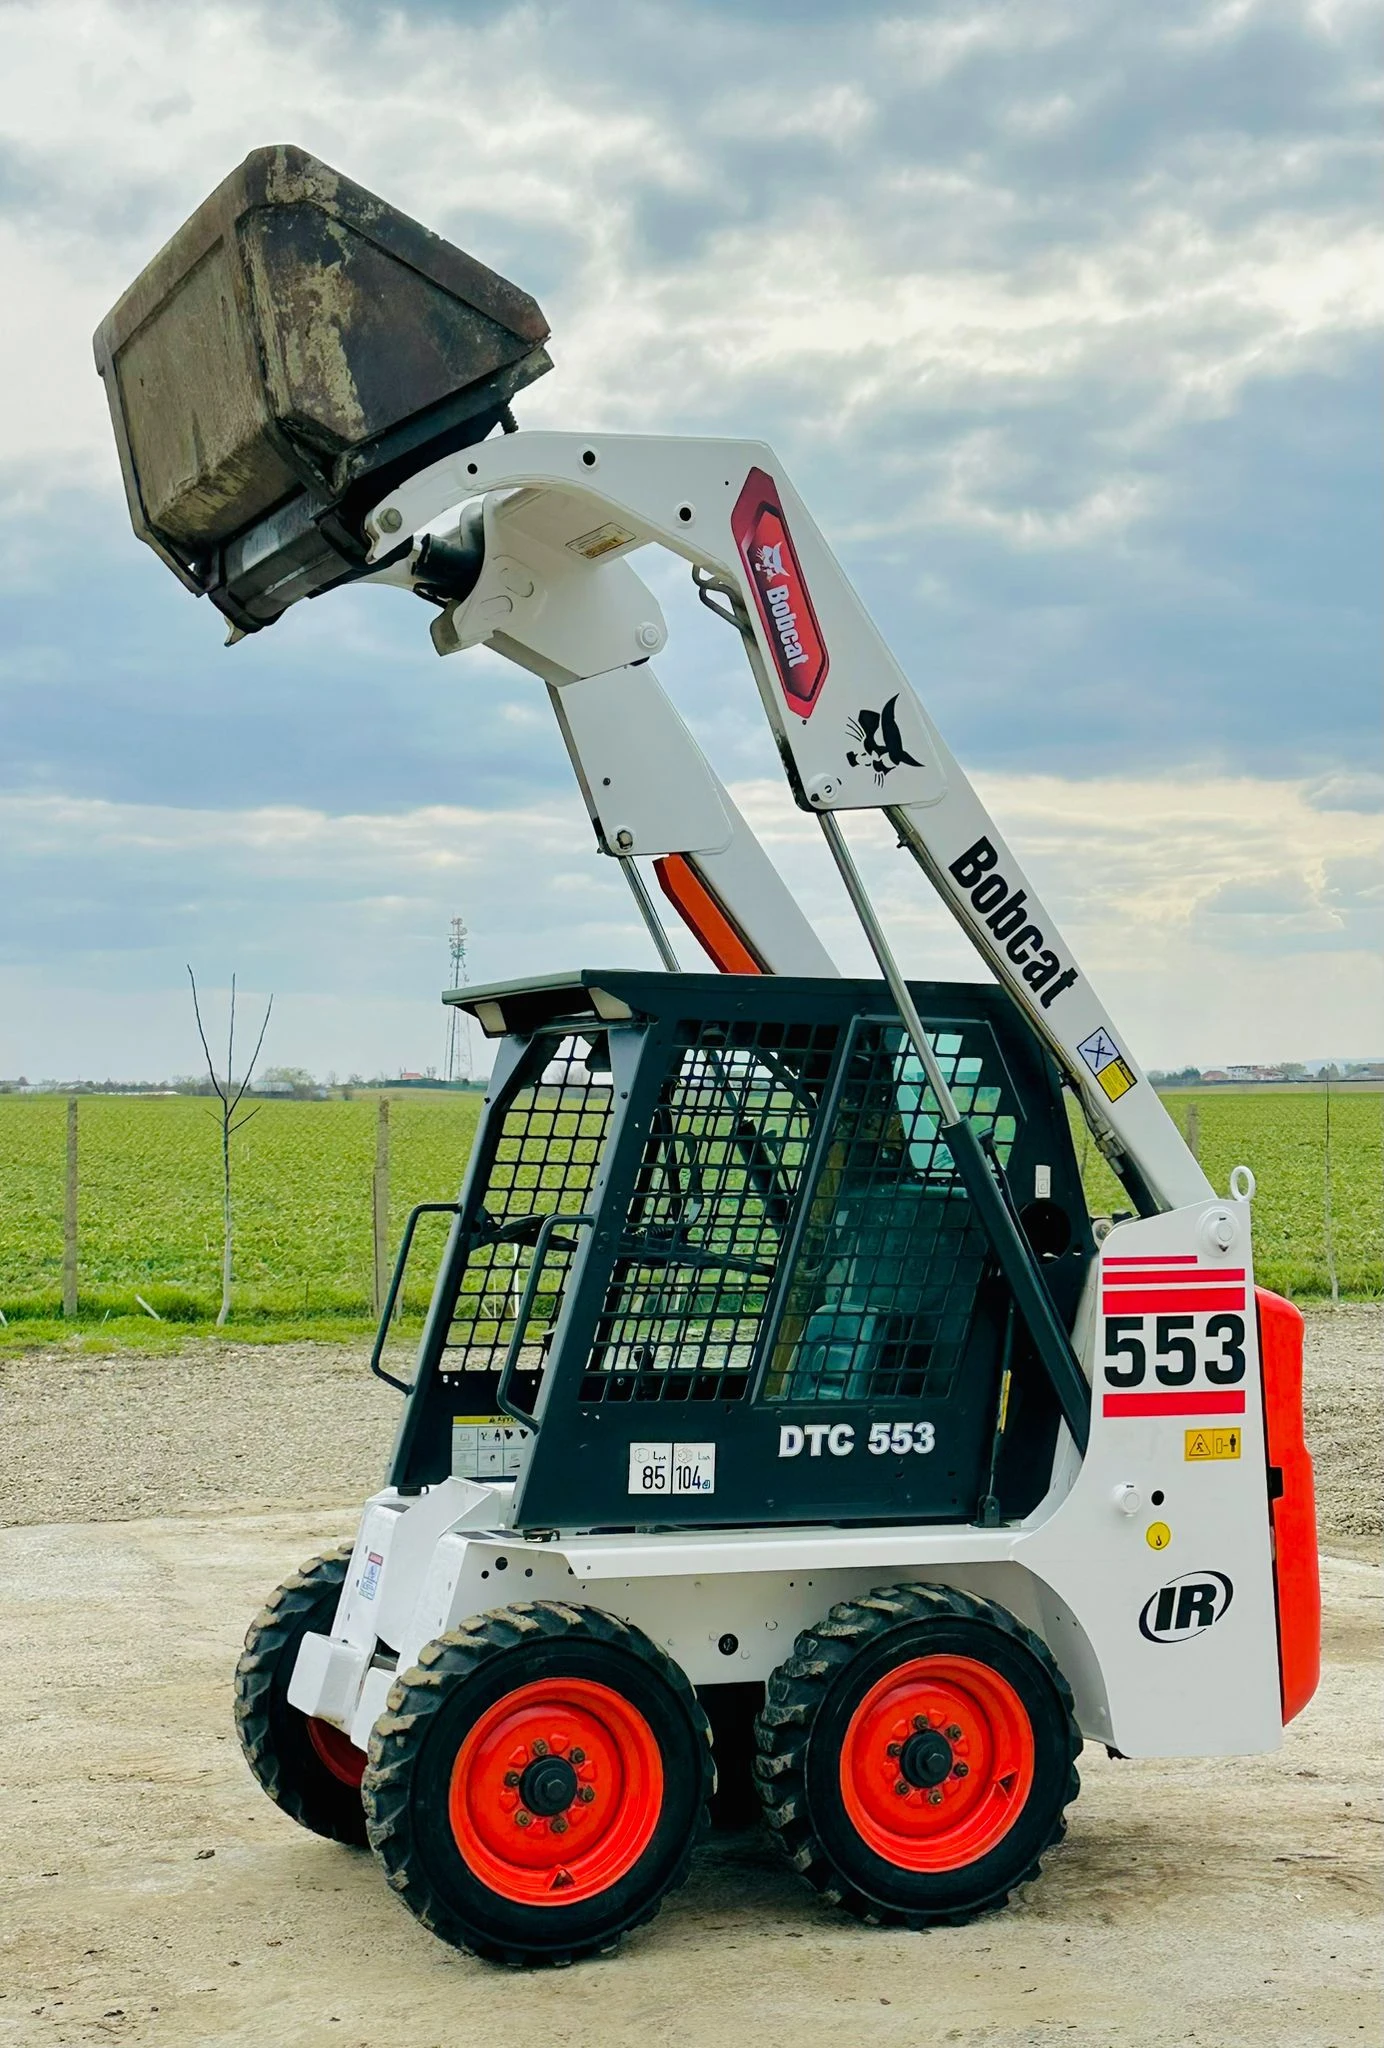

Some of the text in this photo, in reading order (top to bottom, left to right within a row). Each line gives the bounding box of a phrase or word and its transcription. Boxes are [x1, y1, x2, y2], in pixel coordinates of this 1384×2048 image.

[766, 584, 810, 668] Bobcat
[948, 835, 1079, 1010] Bobcat
[1104, 1313, 1246, 1388] 553
[778, 1421, 936, 1457] DTC 553
[642, 1465, 666, 1490] 85
[675, 1465, 701, 1490] 104
[1154, 1583, 1218, 1632] IR
